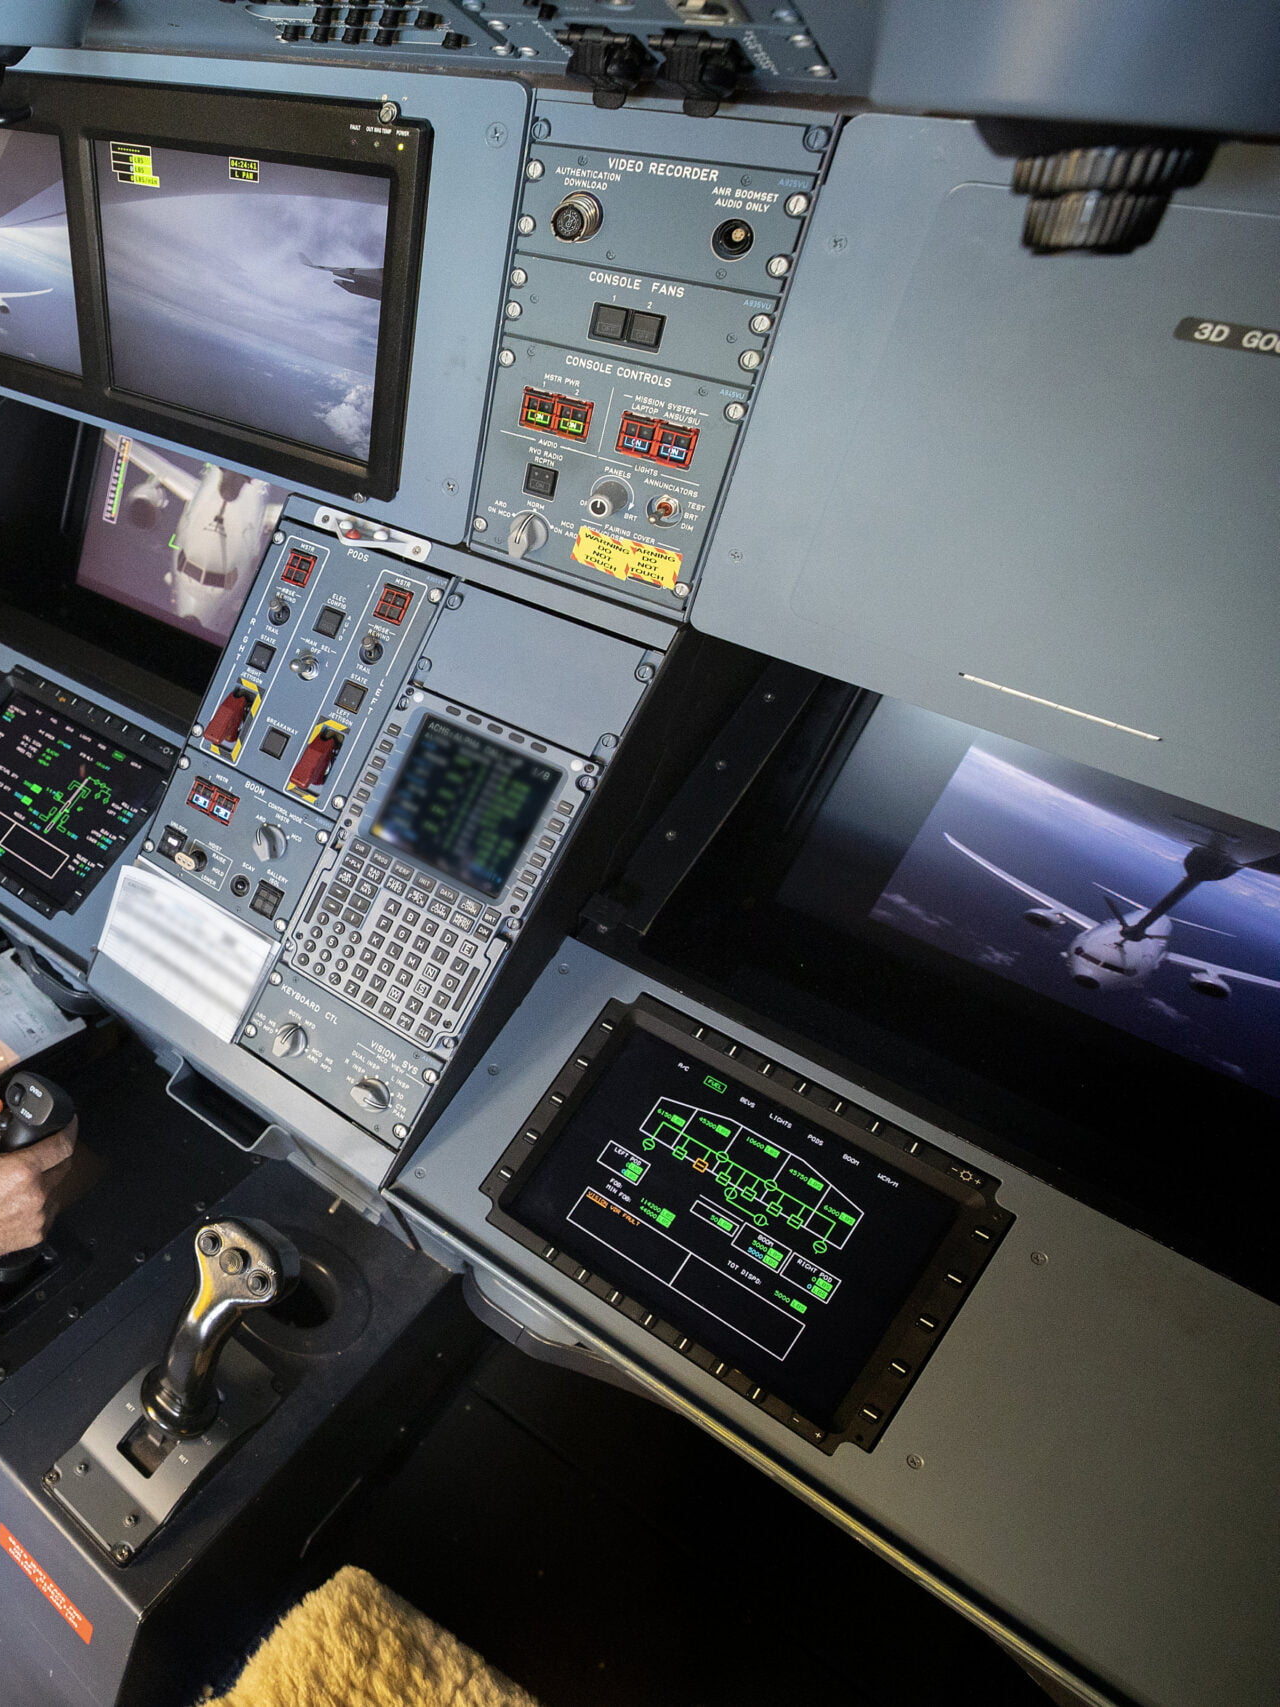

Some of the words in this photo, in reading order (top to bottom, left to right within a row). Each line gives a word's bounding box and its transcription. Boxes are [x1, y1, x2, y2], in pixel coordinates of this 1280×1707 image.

[230, 159, 257, 170] 04:24:41
[608, 157, 644, 173] VIDEO
[648, 162, 720, 182] RECORDER
[241, 171, 254, 180] PAN
[555, 166, 622, 182] AUTHENTICATION
[564, 177, 608, 191] DOWNLOAD
[711, 186, 732, 197] ANR
[734, 188, 779, 203] BOOMSET
[714, 198, 743, 209] AUDIO
[745, 201, 770, 213] ONLY
[589, 271, 643, 291] CONSOLE
[651, 282, 685, 298] FANS
[647, 301, 653, 310] 2
[1193, 321, 1231, 344] 3D
[565, 355, 613, 374] CONSOLE
[616, 366, 673, 388] CONTROLS
[543, 373, 563, 384] MSTR
[564, 377, 581, 388] PWR
[634, 395, 666, 408] MISSION
[667, 402, 697, 416] SYSTEM
[631, 403, 659, 415] LAPTOP
[663, 411, 701, 426] ANSU/SIU
[538, 439, 558, 449] AUDIO
[534, 456, 555, 467] RCPTN
[543, 450, 564, 461] RADIO
[604, 466, 632, 479] PANELS
[634, 465, 659, 477] LIGHTS
[643, 478, 699, 498] ANNUNCIATORS
[487, 506, 497, 514] ON
[526, 500, 545, 510] NORM
[687, 501, 706, 512] TEST
[623, 512, 638, 522] BRT
[683, 512, 699, 522] BRT
[553, 527, 563, 536] ON
[604, 523, 631, 538] FAIRING
[632, 533, 656, 545] COVER
[680, 522, 695, 533] DIM
[300, 542, 316, 553] MSTR
[584, 532, 631, 555] WARNING
[597, 544, 612, 555] DO
[346, 548, 370, 563] PODS
[592, 549, 612, 562] NOT
[634, 547, 676, 563] ARNING
[641, 555, 658, 564] DO
[584, 554, 617, 572] TOUCH
[637, 561, 659, 572] NOT
[630, 567, 665, 582] TOUCH
[394, 577, 412, 588] MSTR
[326, 597, 347, 610] CONFIG
[332, 593, 347, 604] ELEC
[265, 624, 279, 636] TRAIL
[367, 628, 391, 642] REWIND
[260, 633, 277, 645] STATE
[305, 638, 318, 648] MAN
[320, 644, 332, 654] SEL
[310, 646, 322, 655] OFF
[355, 663, 371, 675] TRAIL
[240, 672, 263, 684] JETTISON
[350, 673, 369, 685] STATE
[328, 711, 354, 727] JETTISON
[335, 708, 351, 719] LEFT
[265, 716, 299, 736] BREAKAWAY
[244, 781, 266, 797] BOOM
[267, 801, 289, 817] CONTROL
[289, 812, 304, 825] MODE
[275, 813, 291, 825] INSTR
[169, 820, 189, 834] UNLOCK
[354, 844, 365, 853] DIR
[439, 888, 454, 899] DATA
[483, 913, 496, 923] BRT
[280, 983, 321, 1013] KEYBOARD
[324, 1011, 339, 1025] CTL
[370, 1039, 397, 1061] VISION
[401, 1060, 419, 1076] SYS
[677, 1062, 690, 1073] A/C
[707, 1078, 722, 1091] FUEL
[20, 1107, 33, 1120] STOP
[395, 1103, 407, 1114] CTR
[768, 1112, 793, 1130] LIGHTS
[746, 1136, 765, 1150] 10600
[807, 1134, 824, 1147] PODS
[614, 1146, 629, 1159] LEFT
[629, 1155, 642, 1166] POD
[842, 1153, 860, 1167] BOOM
[605, 1183, 619, 1195] MIN
[587, 1191, 609, 1207] VISION
[621, 1211, 641, 1227] FAULT
[640, 1197, 662, 1213] 114200
[823, 1204, 840, 1218] 6300
[709, 1214, 719, 1223] 50
[751, 1239, 768, 1253] 5000
[757, 1234, 775, 1248] BOOM
[747, 1246, 764, 1260] 5000
[727, 1259, 740, 1271] TOT
[740, 1269, 762, 1286] DISPD:
[796, 1258, 818, 1274] RIGHT
[819, 1271, 833, 1283] POD
[774, 1289, 791, 1304] 5000
